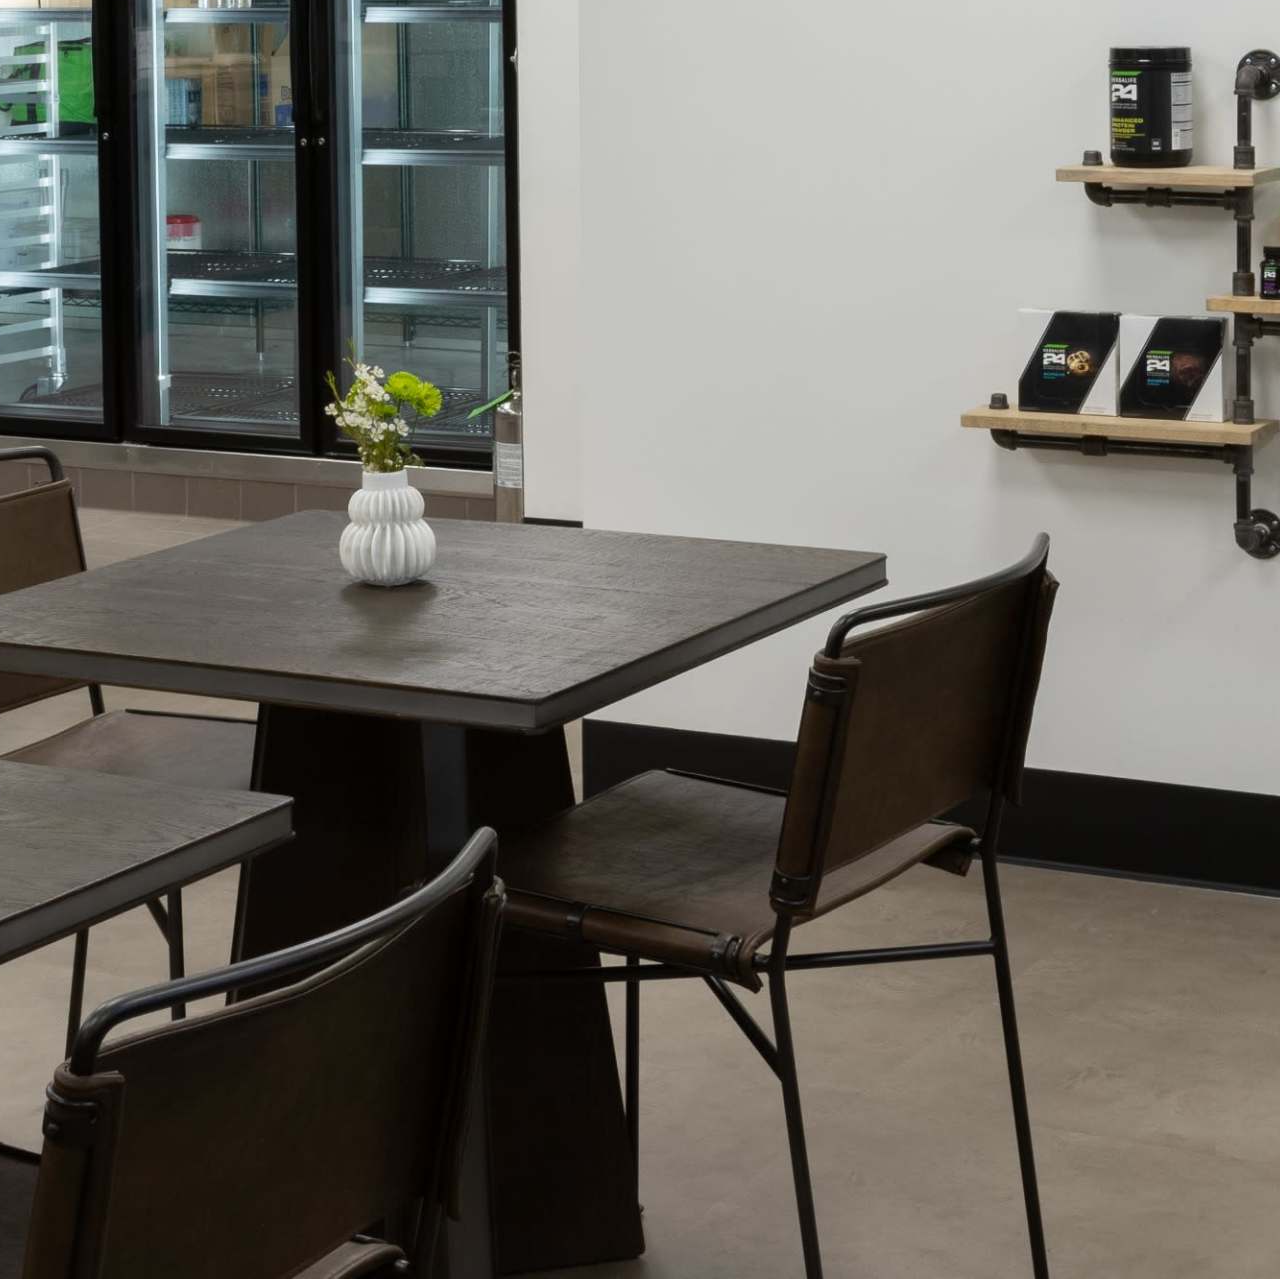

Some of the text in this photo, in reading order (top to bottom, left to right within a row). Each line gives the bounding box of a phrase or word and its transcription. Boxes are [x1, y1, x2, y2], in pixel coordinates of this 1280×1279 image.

[1111, 83, 1137, 102] 24
[1042, 352, 1066, 366] 24
[1146, 359, 1170, 372] 24
